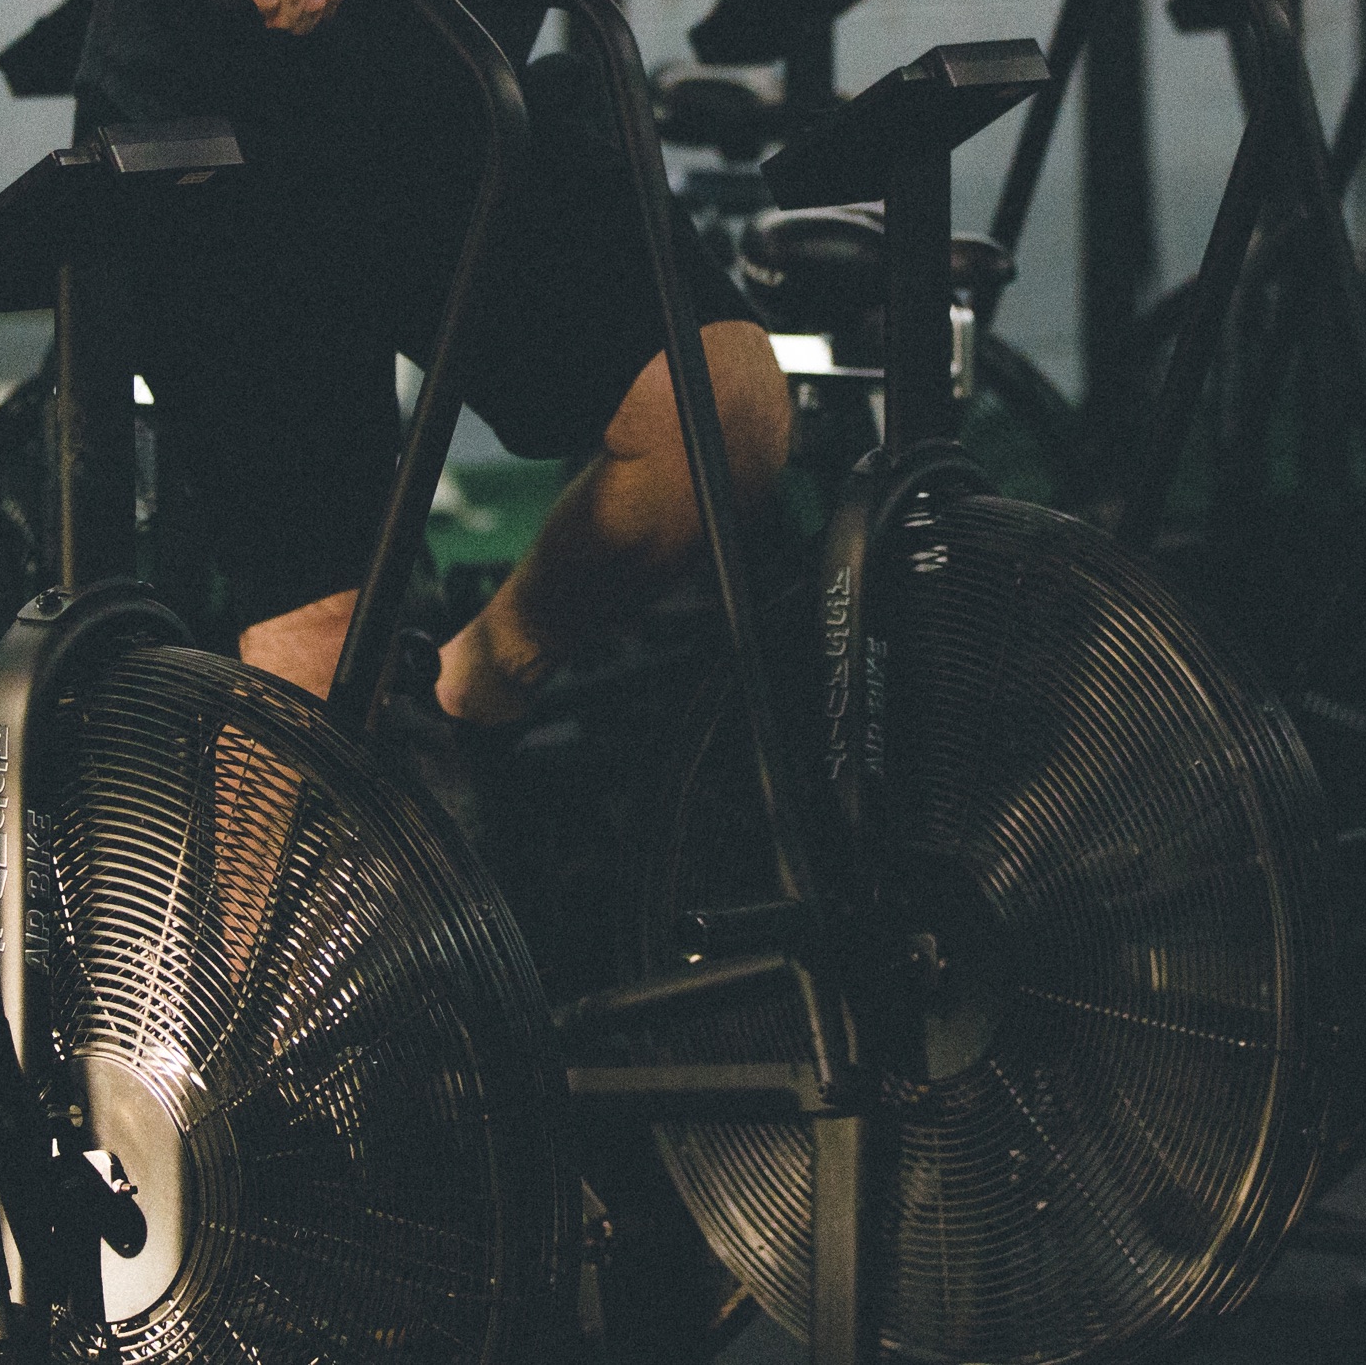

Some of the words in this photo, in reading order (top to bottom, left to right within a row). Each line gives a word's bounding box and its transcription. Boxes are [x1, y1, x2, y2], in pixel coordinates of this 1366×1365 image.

[825, 565, 851, 779] ASSAULT
[26, 809, 52, 899] BIKE
[24, 908, 51, 976] AIR
